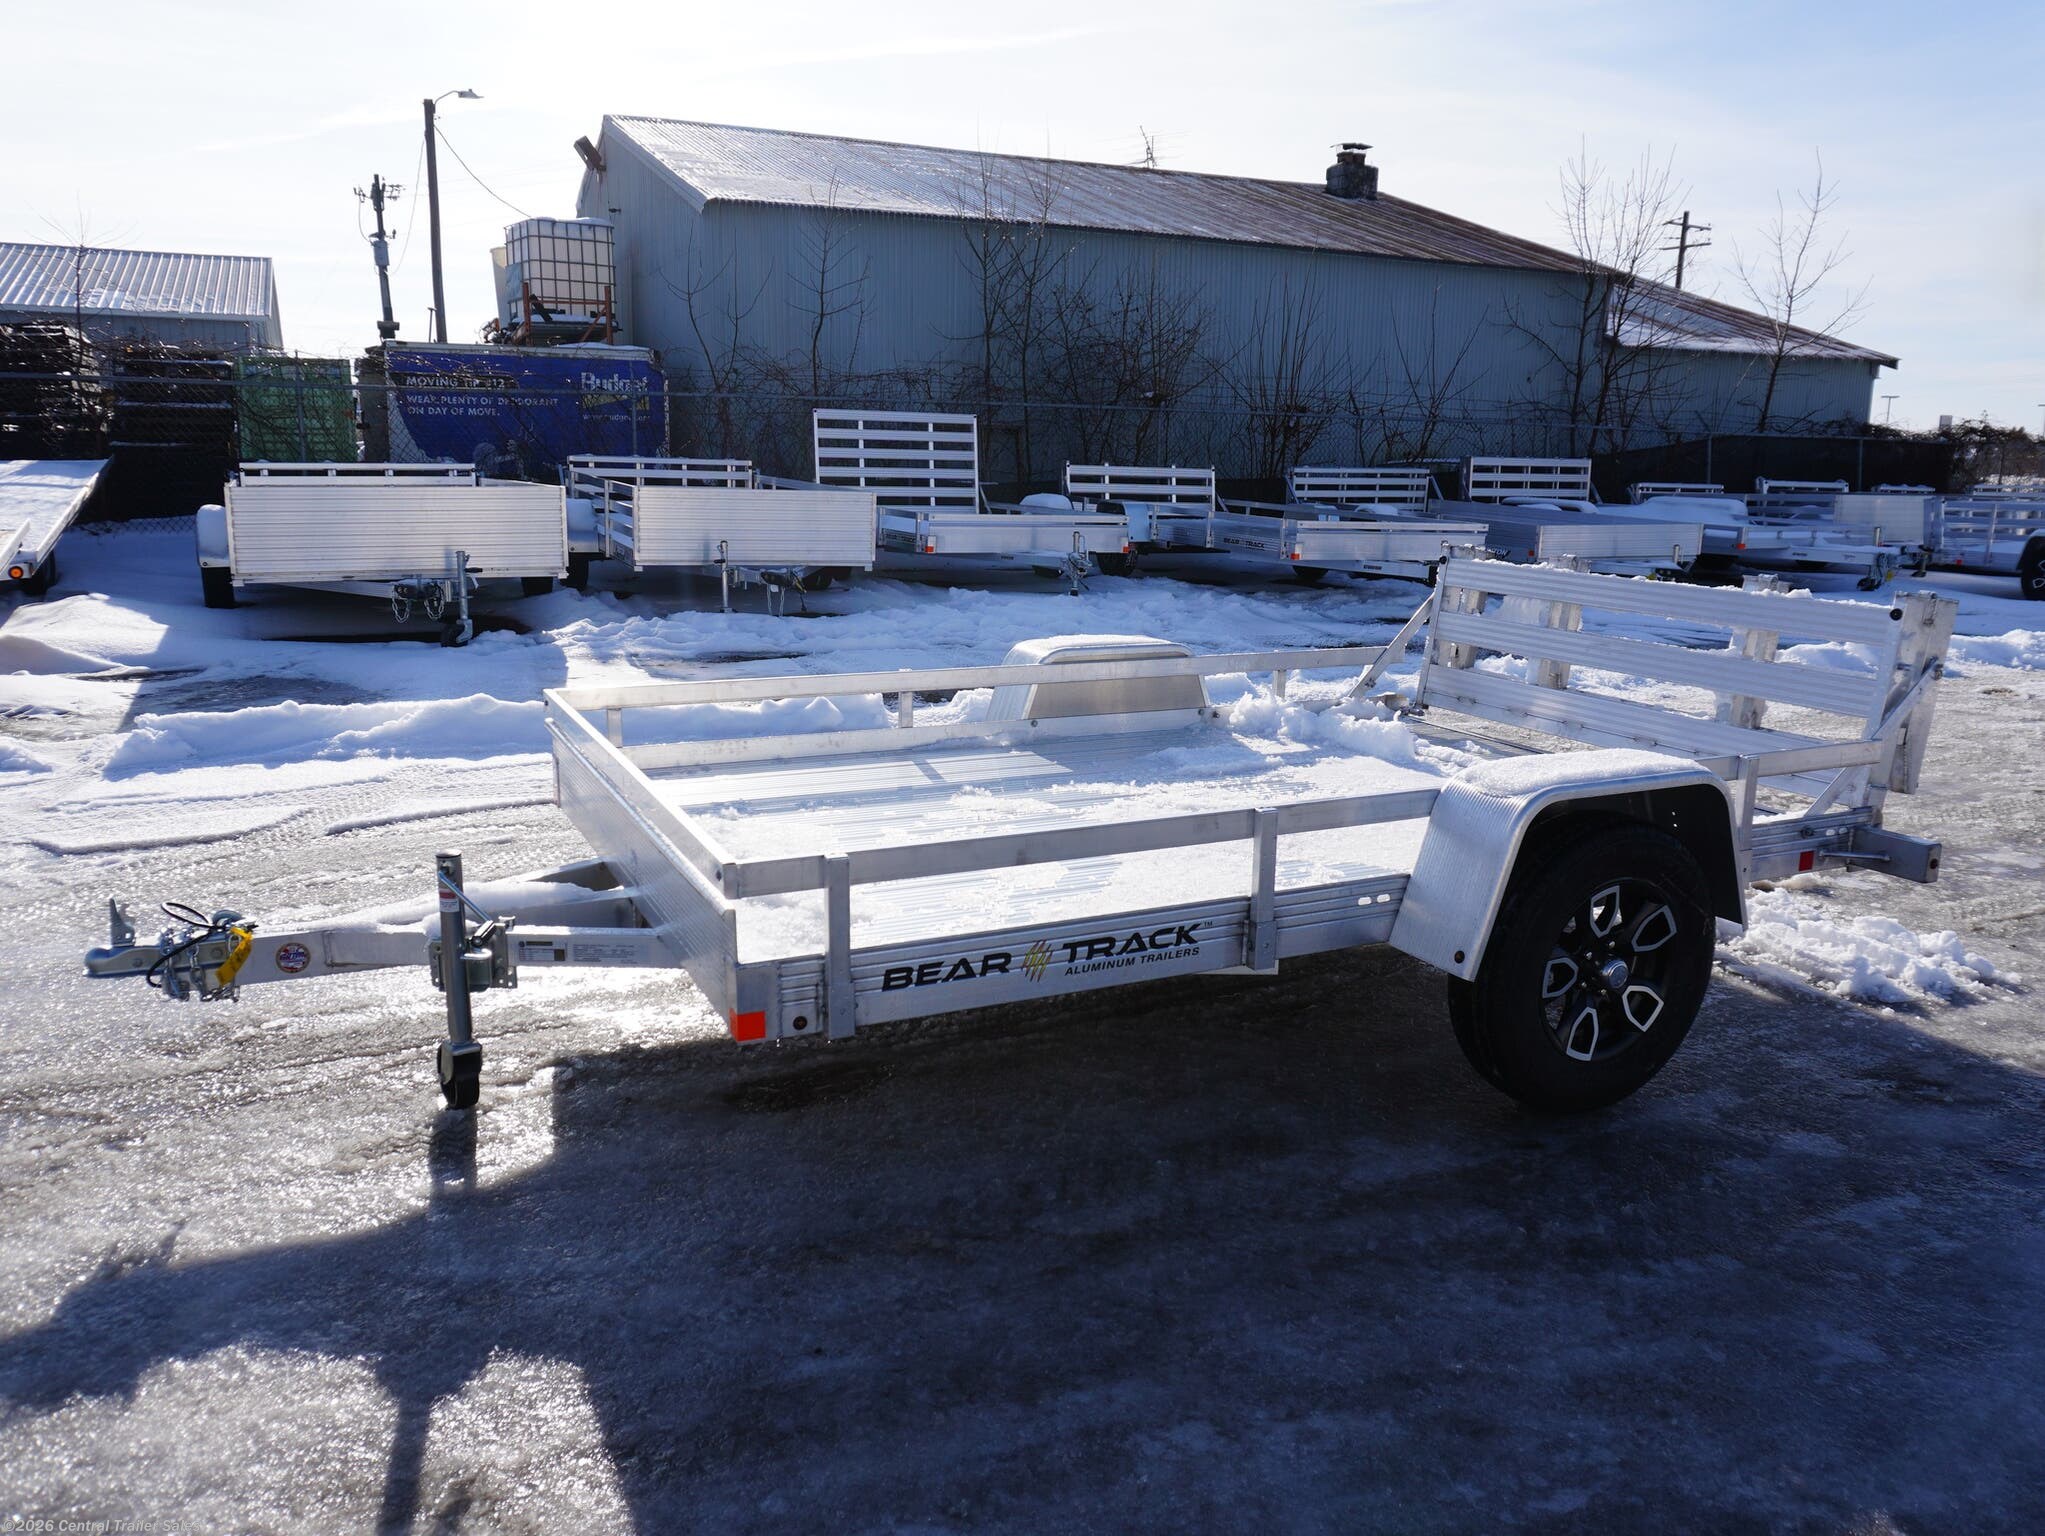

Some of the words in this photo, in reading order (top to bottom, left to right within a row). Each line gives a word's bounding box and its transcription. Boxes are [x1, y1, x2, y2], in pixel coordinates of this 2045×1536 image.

[406, 376, 458, 388] MOVING
[440, 395, 478, 405] PLENTY
[480, 396, 493, 406] OF
[407, 407, 425, 416] ON
[428, 407, 448, 416] DAY
[450, 407, 464, 416] OF
[467, 407, 501, 417] MOVE.
[1245, 540, 1265, 549] TRACK
[882, 951, 1012, 992] BEAR
[1062, 922, 1201, 964] TRACK
[1064, 956, 1136, 977] ALUMINUM
[1140, 946, 1200, 965] TRAILERS
